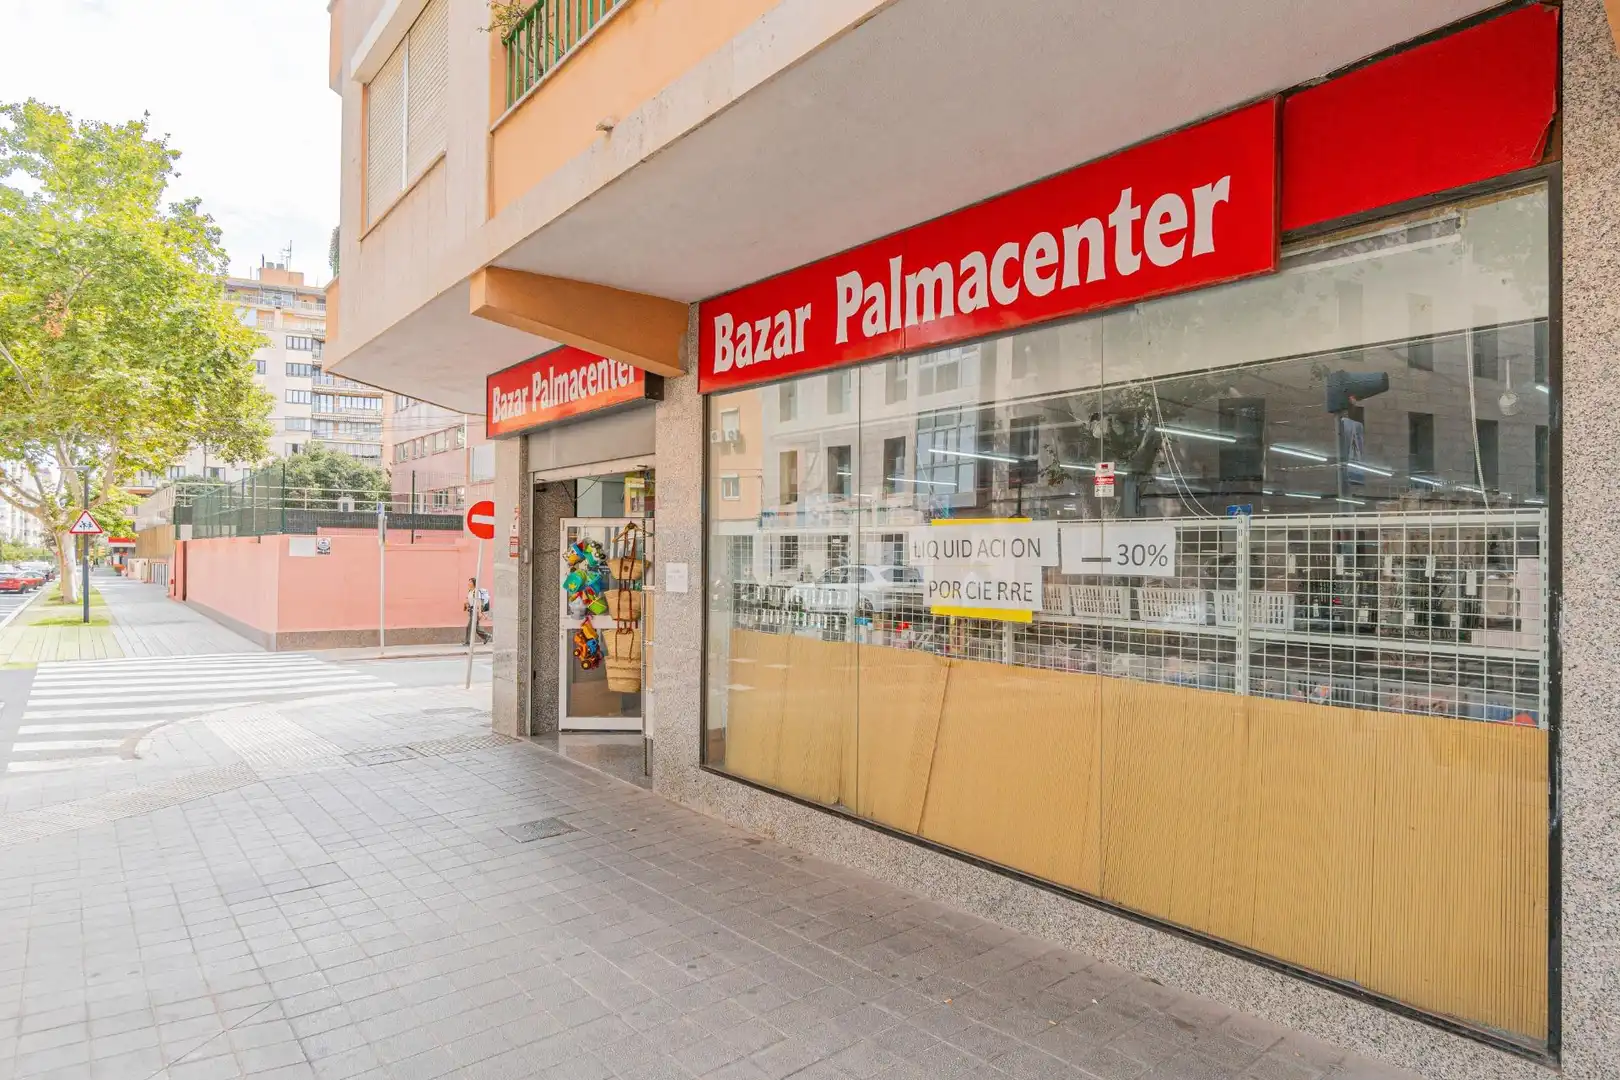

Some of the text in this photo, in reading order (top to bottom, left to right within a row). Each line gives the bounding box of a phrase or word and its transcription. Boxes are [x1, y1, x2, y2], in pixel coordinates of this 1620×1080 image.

[713, 176, 1231, 374] Bazar Palmacenter
[492, 386, 529, 424] Bazar
